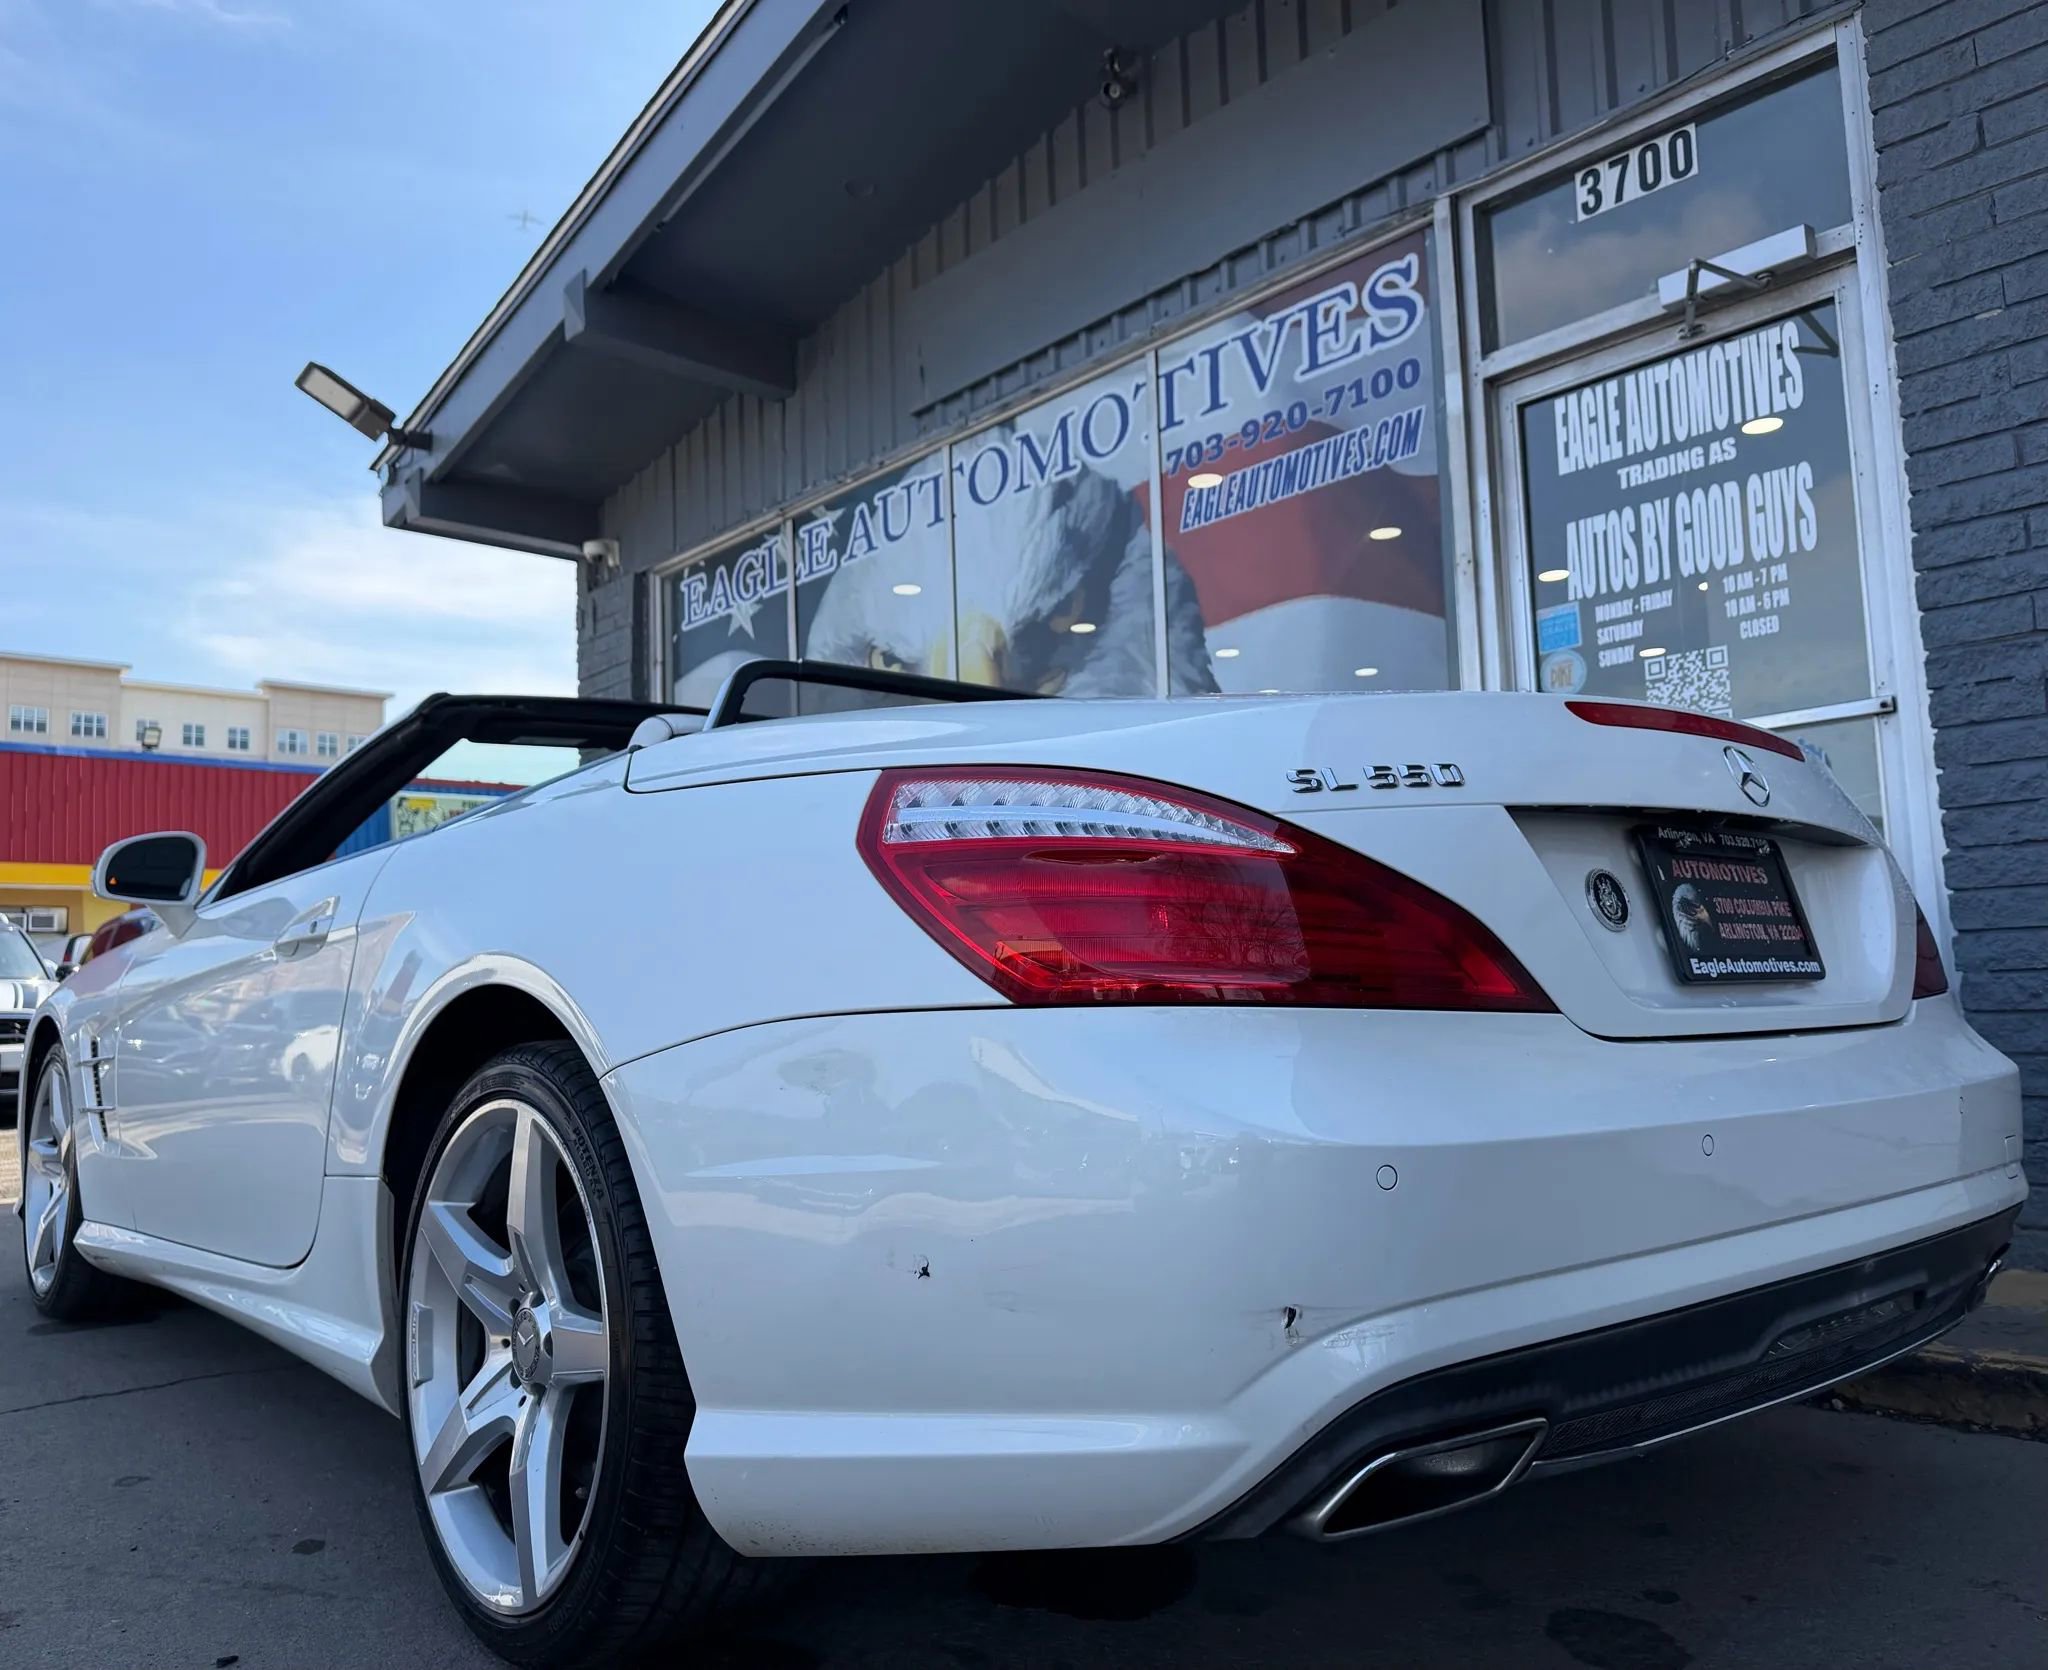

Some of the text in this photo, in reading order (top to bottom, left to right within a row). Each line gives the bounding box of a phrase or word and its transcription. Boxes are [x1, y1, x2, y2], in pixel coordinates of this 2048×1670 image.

[1580, 129, 1694, 216] 3700
[1554, 321, 1804, 476] EAGLE AUTOMOTIVES
[1166, 357, 1421, 476] 703-920-7100
[681, 252, 1425, 631] EAGLE AUTOMOTIVES
[1180, 405, 1425, 533] EAGLEAUTOMOTIVES.COM
[1617, 436, 1737, 490] TRADING AS
[1566, 460, 1818, 601] AUTOS BY GOOD GUYS
[1737, 570, 1754, 592] AM
[1770, 563, 1788, 584] PM
[1595, 598, 1633, 624] MONDAY
[1640, 589, 1673, 613] FRIDAY
[1739, 594, 1756, 616] AM
[1772, 587, 1790, 608] PM
[1597, 619, 1644, 646] SATURDAY
[1740, 615, 1780, 640] CLOSED
[1598, 644, 1635, 669] SUNDAY
[1286, 763, 1466, 793] SL 550
[1702, 833, 1716, 845] VA
[1671, 859, 1769, 885] AUTOMOTIVES
[1690, 957, 1821, 978] EagleAutomotives.com
